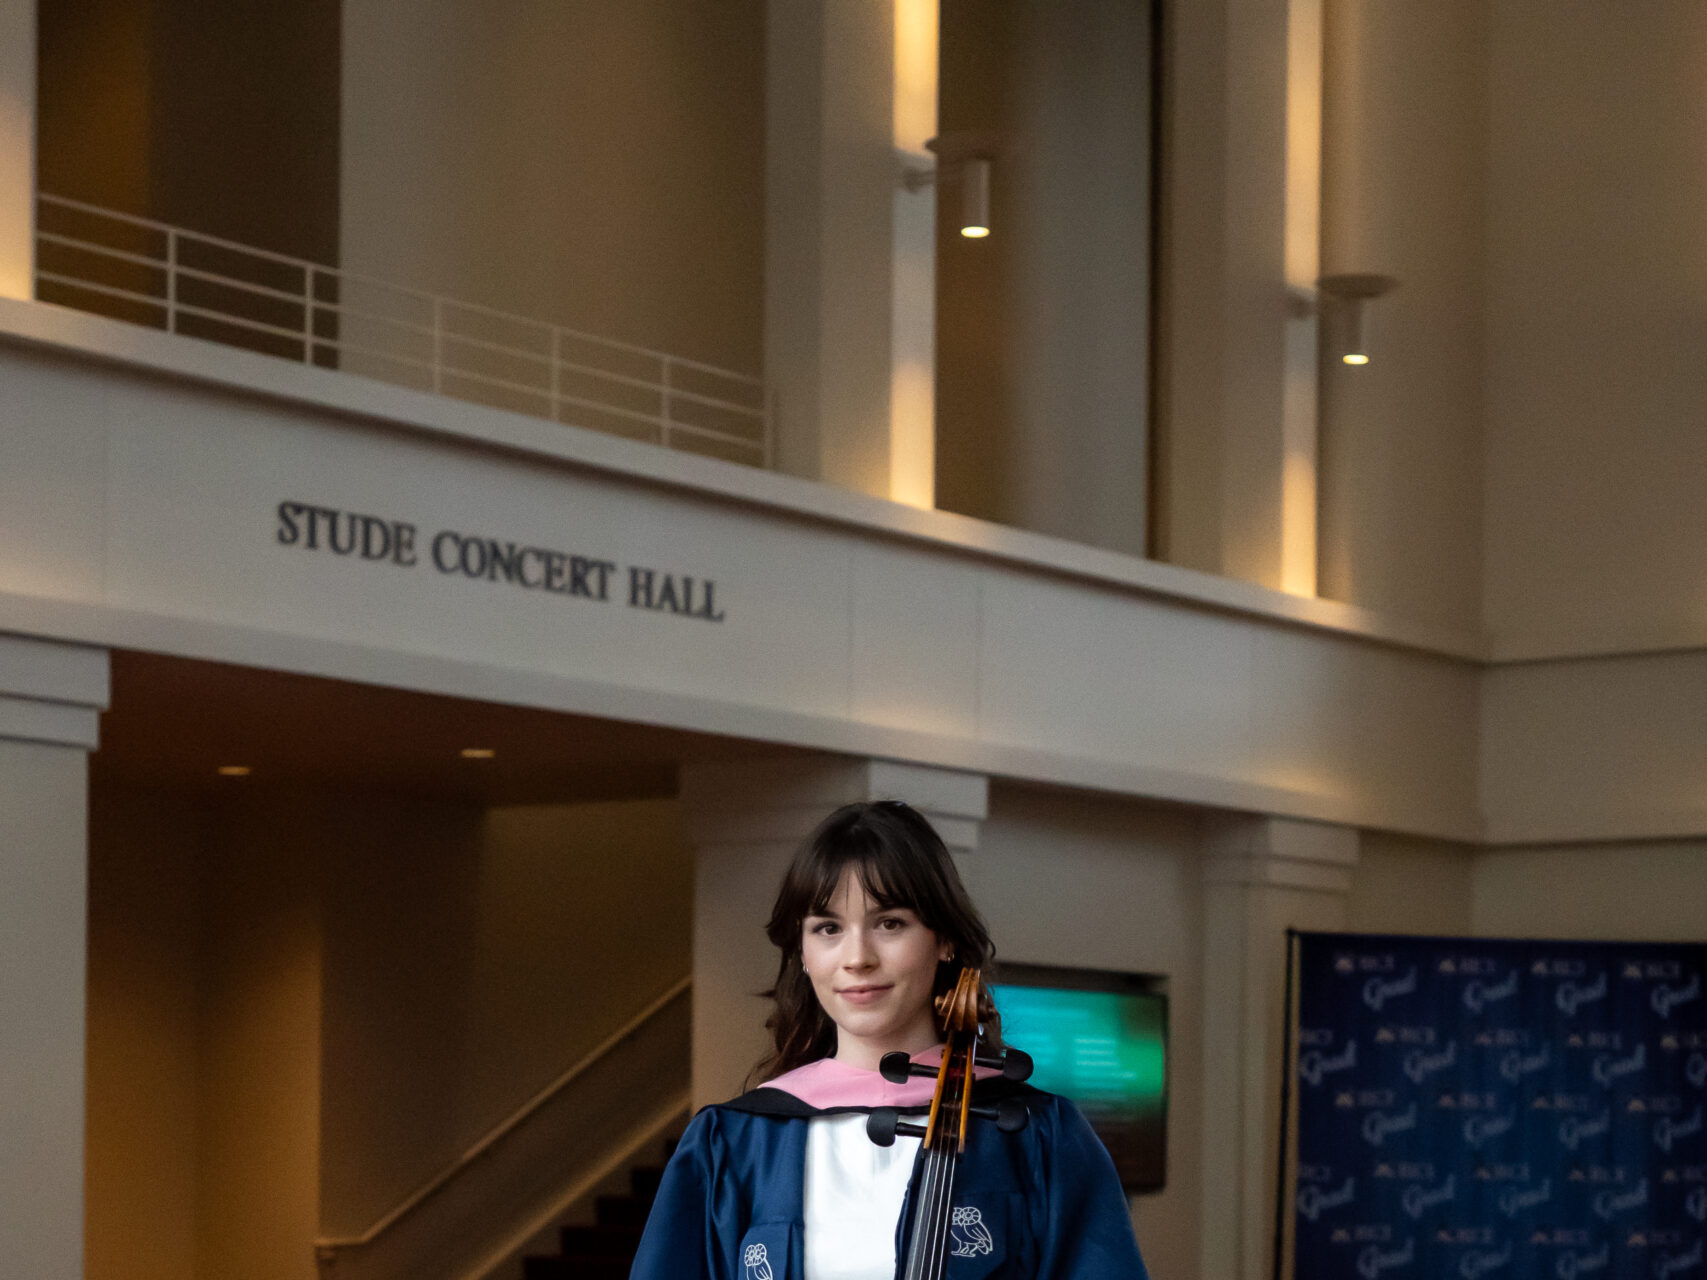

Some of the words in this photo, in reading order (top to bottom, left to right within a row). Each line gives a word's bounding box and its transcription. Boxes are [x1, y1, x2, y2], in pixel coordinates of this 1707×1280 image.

[276, 501, 417, 567] STUDE
[431, 531, 615, 602] CONCERT
[628, 566, 725, 621] HALL
